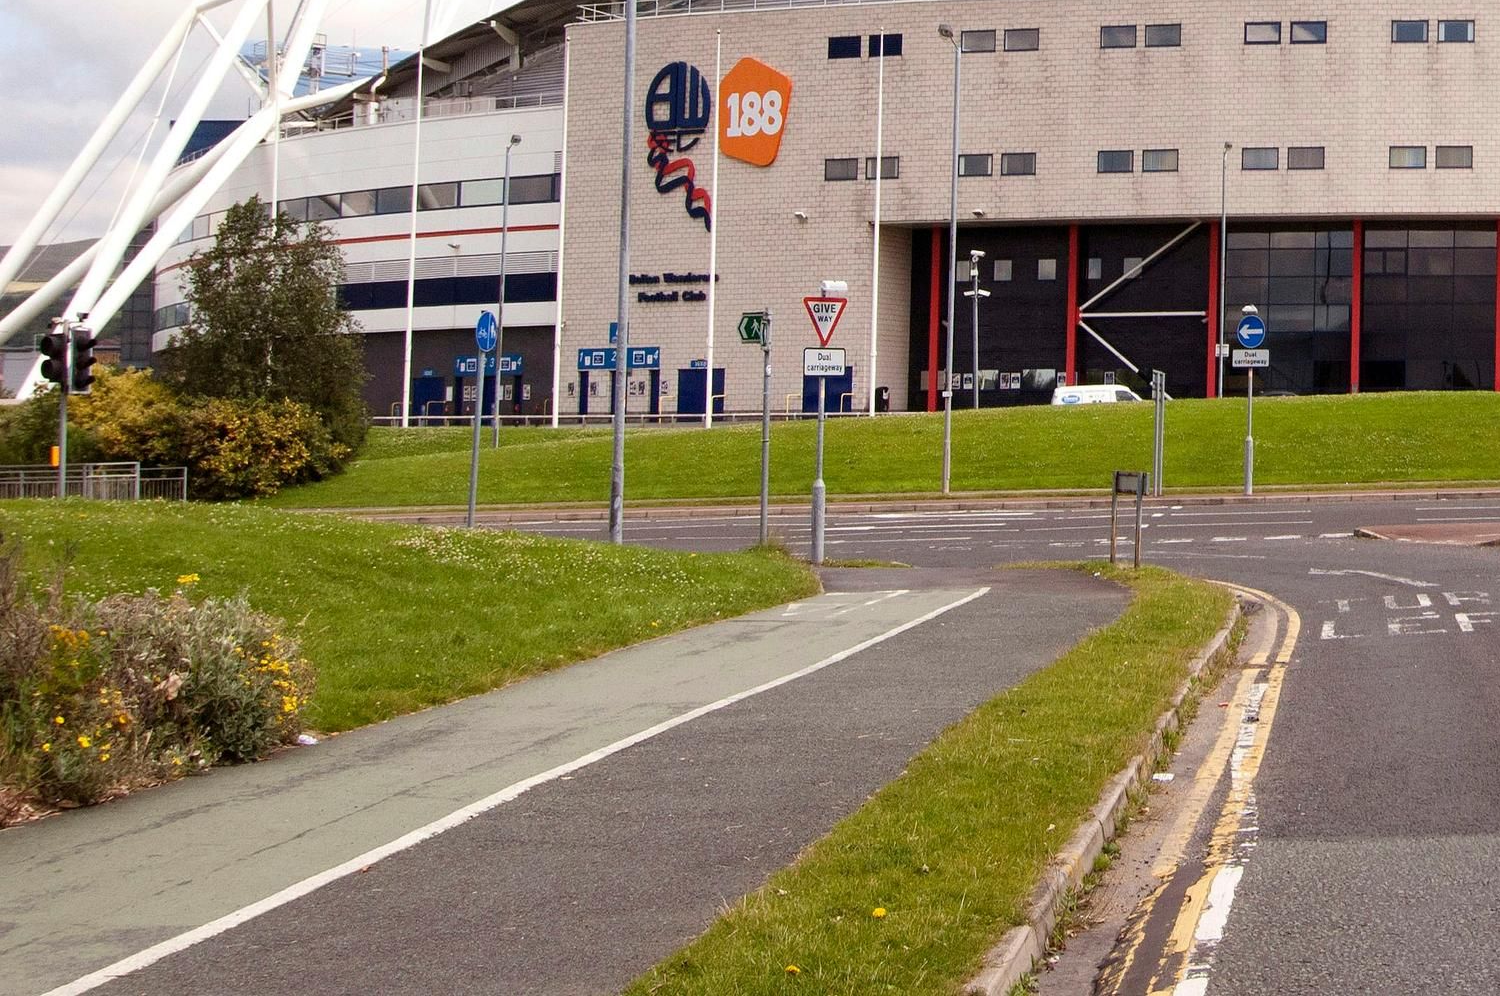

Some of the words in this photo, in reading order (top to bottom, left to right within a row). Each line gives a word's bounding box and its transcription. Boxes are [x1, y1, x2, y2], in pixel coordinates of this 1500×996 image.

[726, 90, 783, 138] 188
[663, 272, 720, 283] Wanderes
[682, 290, 707, 302] Club
[813, 304, 837, 313] GIVE
[817, 353, 832, 361] Dual
[806, 364, 843, 372] carriageway
